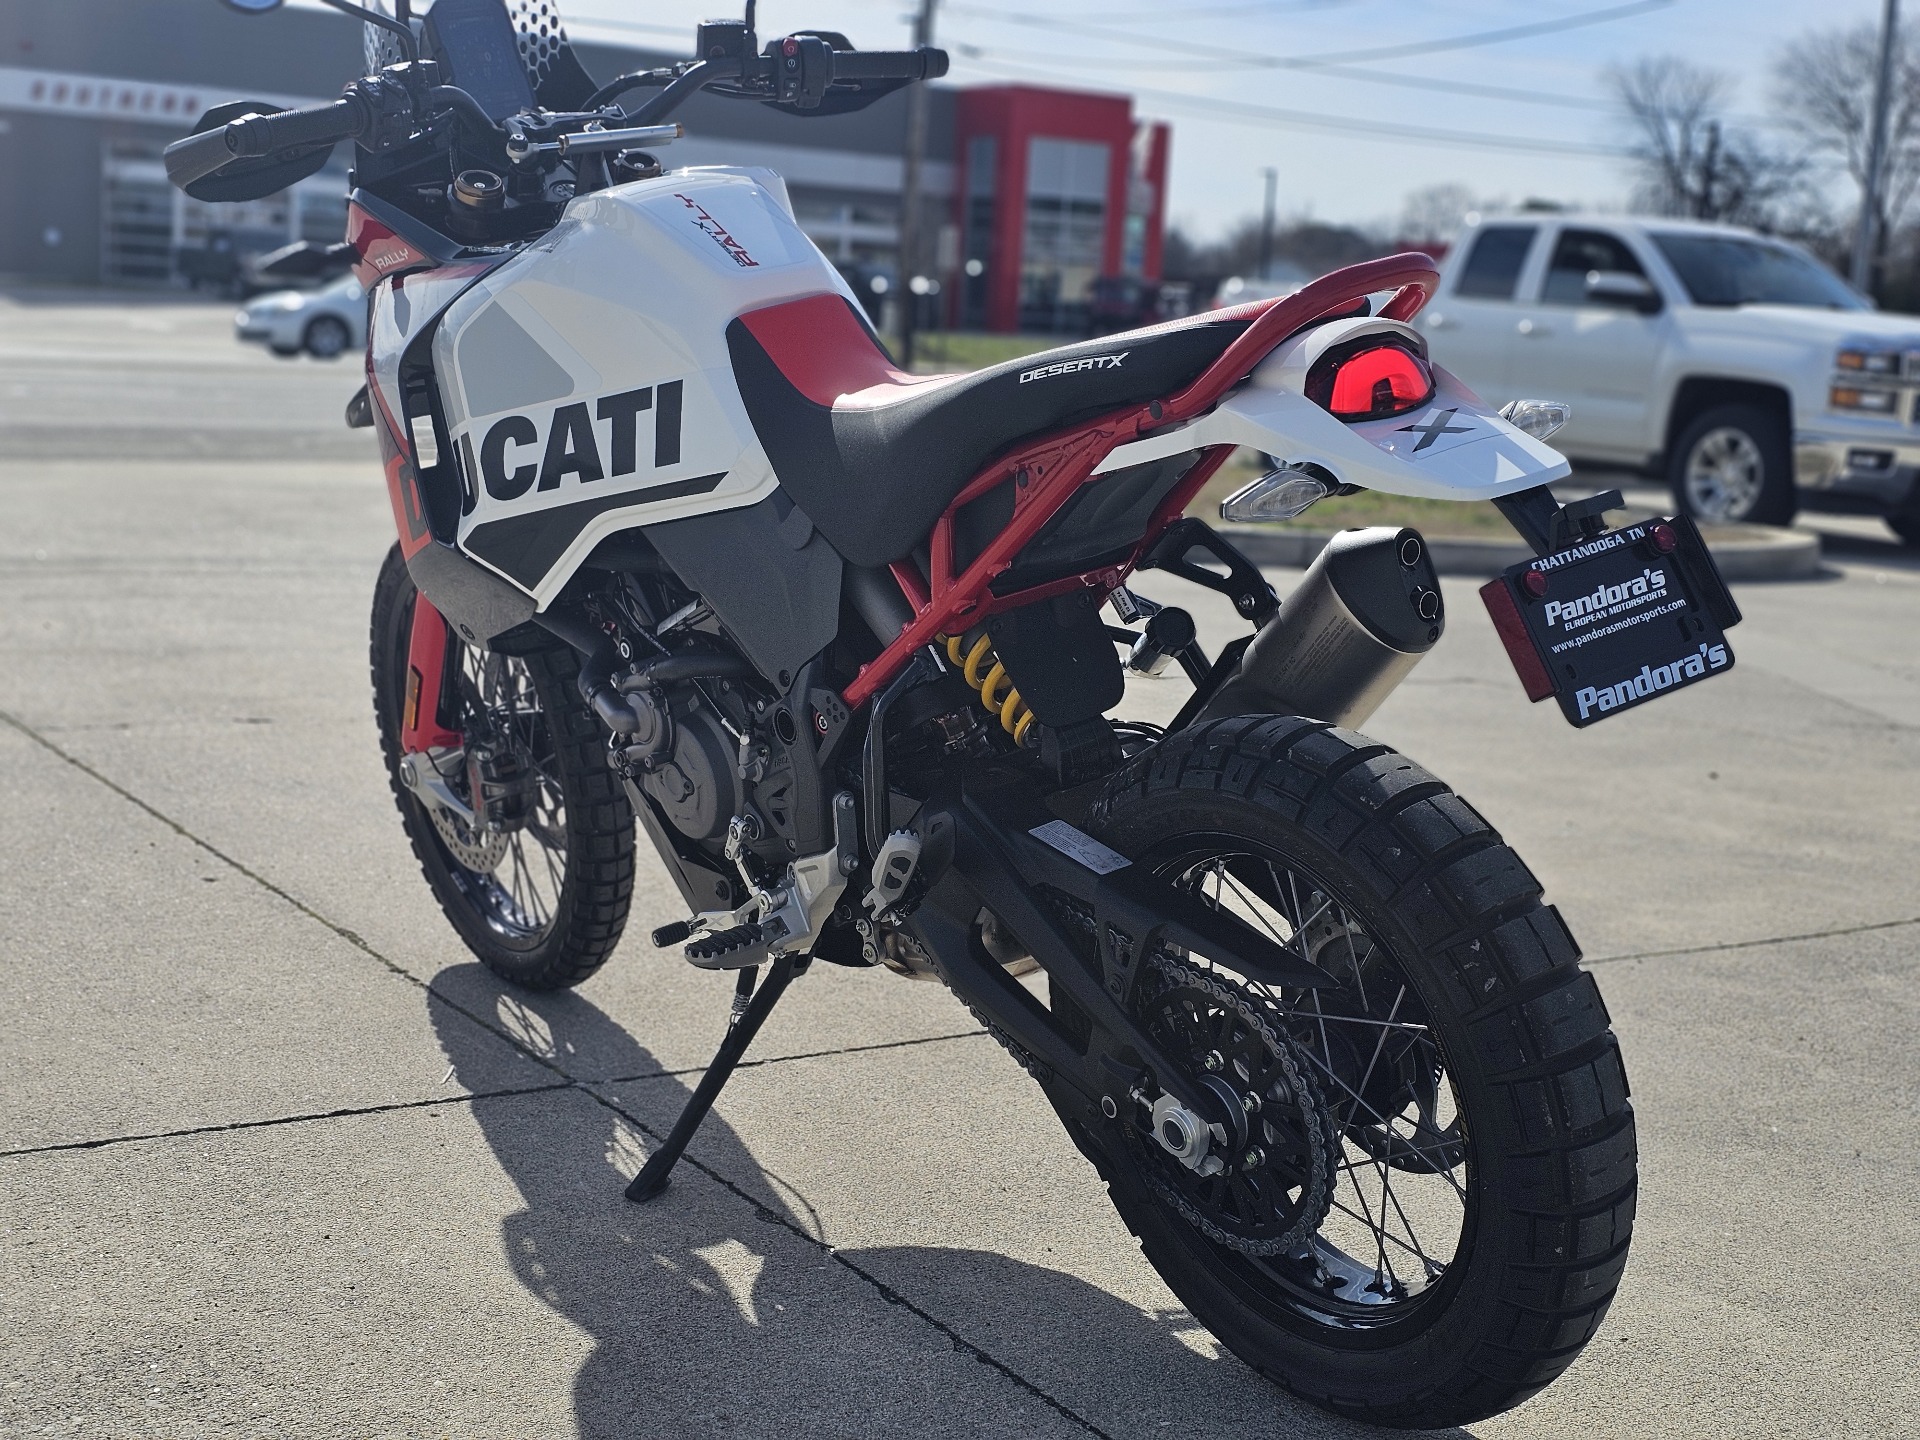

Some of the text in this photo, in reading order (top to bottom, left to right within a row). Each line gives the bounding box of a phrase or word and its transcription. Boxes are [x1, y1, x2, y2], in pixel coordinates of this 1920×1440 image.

[674, 194, 759, 266] RALLY
[375, 248, 409, 269] RALLY
[1019, 351, 1131, 384] DESERTX
[1531, 526, 1646, 572] CHATTANOOGA TN
[1544, 568, 1667, 626] Pandora's
[1564, 587, 1668, 632] EUROPEAN MOTORSPORTS
[1551, 597, 1687, 654] www.pandorasmotorsports.com
[1575, 642, 1728, 720] Pandora's
